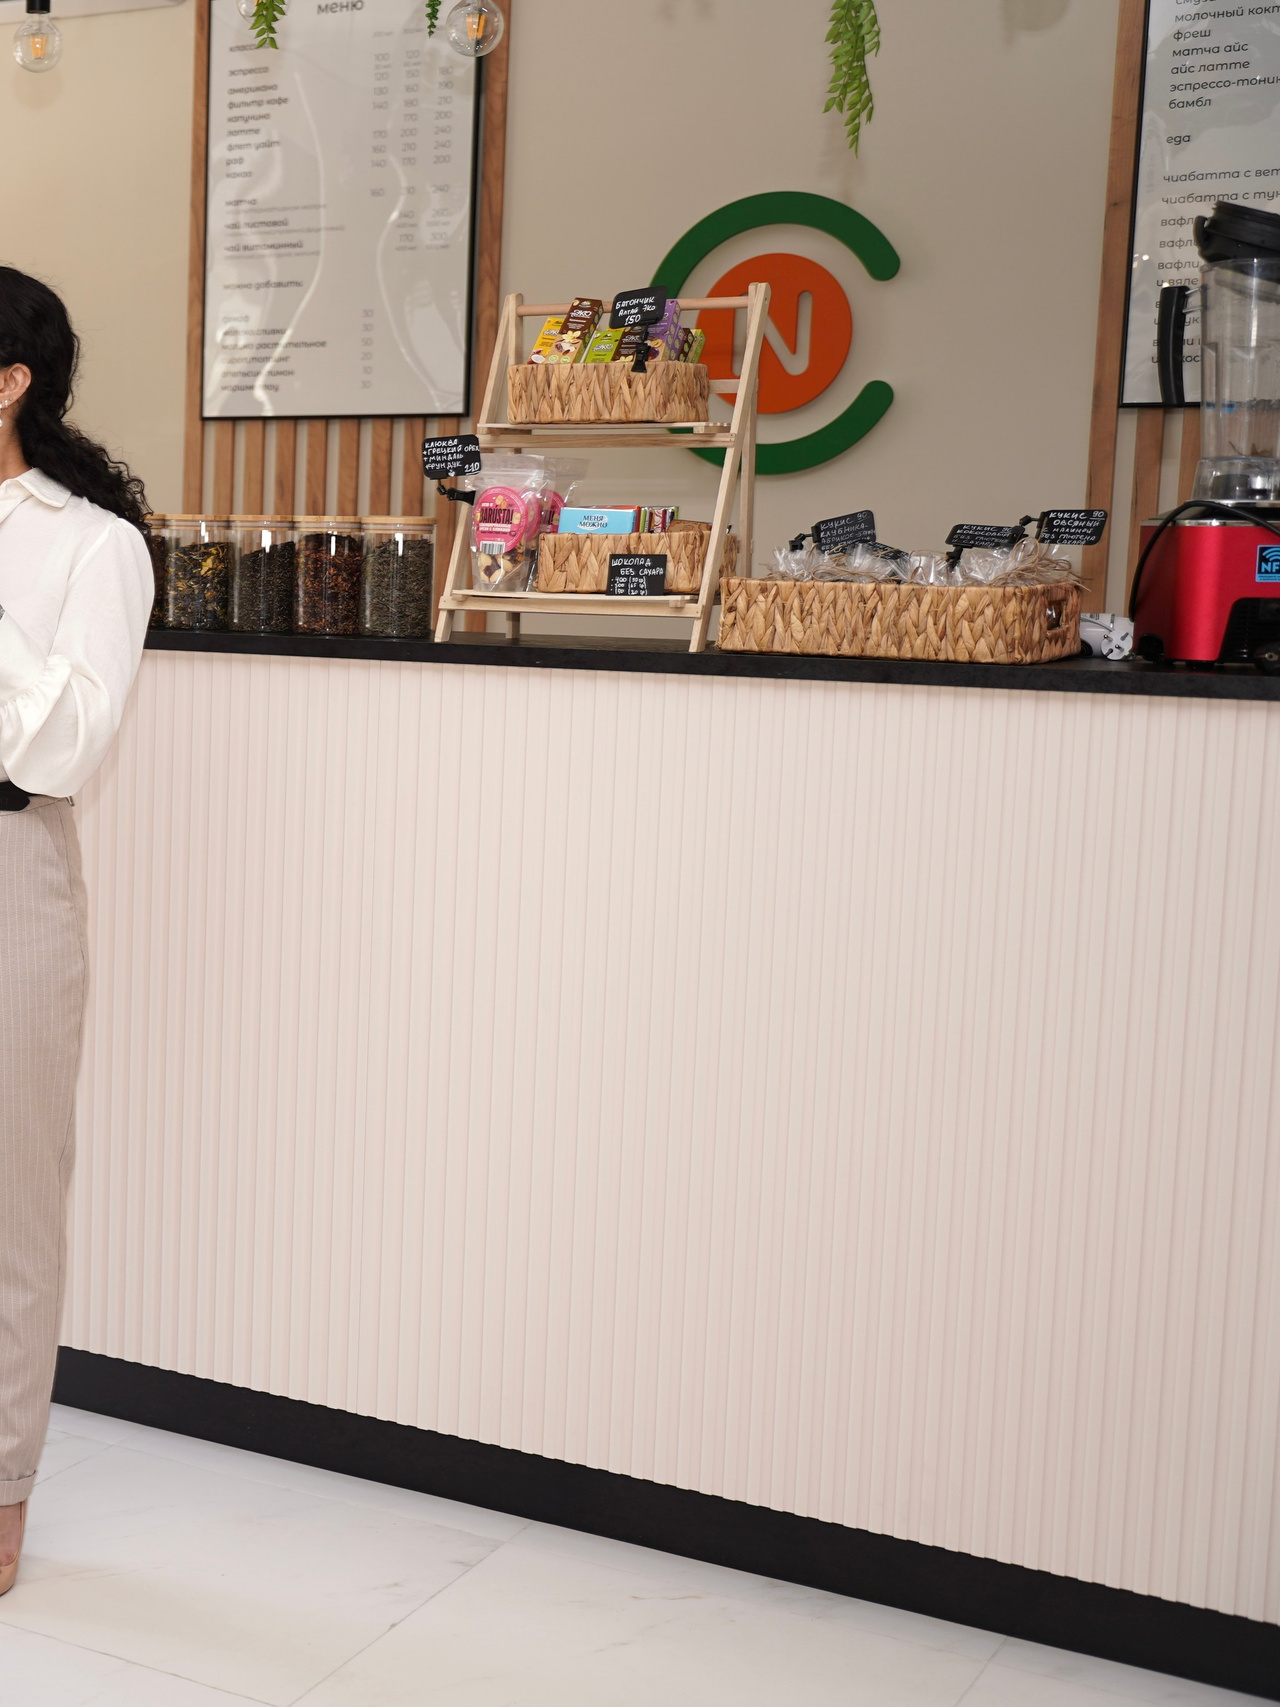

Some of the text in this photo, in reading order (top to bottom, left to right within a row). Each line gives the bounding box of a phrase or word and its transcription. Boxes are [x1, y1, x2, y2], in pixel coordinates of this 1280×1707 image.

[317, 0, 365, 15] меню
[1175, 6, 1244, 22] молочный
[1173, 29, 1211, 41] фреш
[1172, 42, 1249, 57] матча айс
[1171, 61, 1250, 74] айс латте
[1169, 97, 1212, 109] бамбл
[1166, 135, 1190, 146] еда
[1163, 170, 1240, 182] чиабатта
[1243, 170, 1251, 178] с
[1162, 193, 1238, 204] чиабатта
[1242, 192, 1249, 200] с
[1157, 260, 1200, 271] вафли
[624, 314, 641, 326] 150
[425, 438, 458, 448] КЛЮКВА
[464, 462, 480, 472] 210
[1092, 510, 1104, 518] 90
[820, 512, 868, 530] КУКИС 90
[612, 557, 652, 567] ШОКОЛАД
[620, 567, 664, 576] БЕЗ САХАРА
